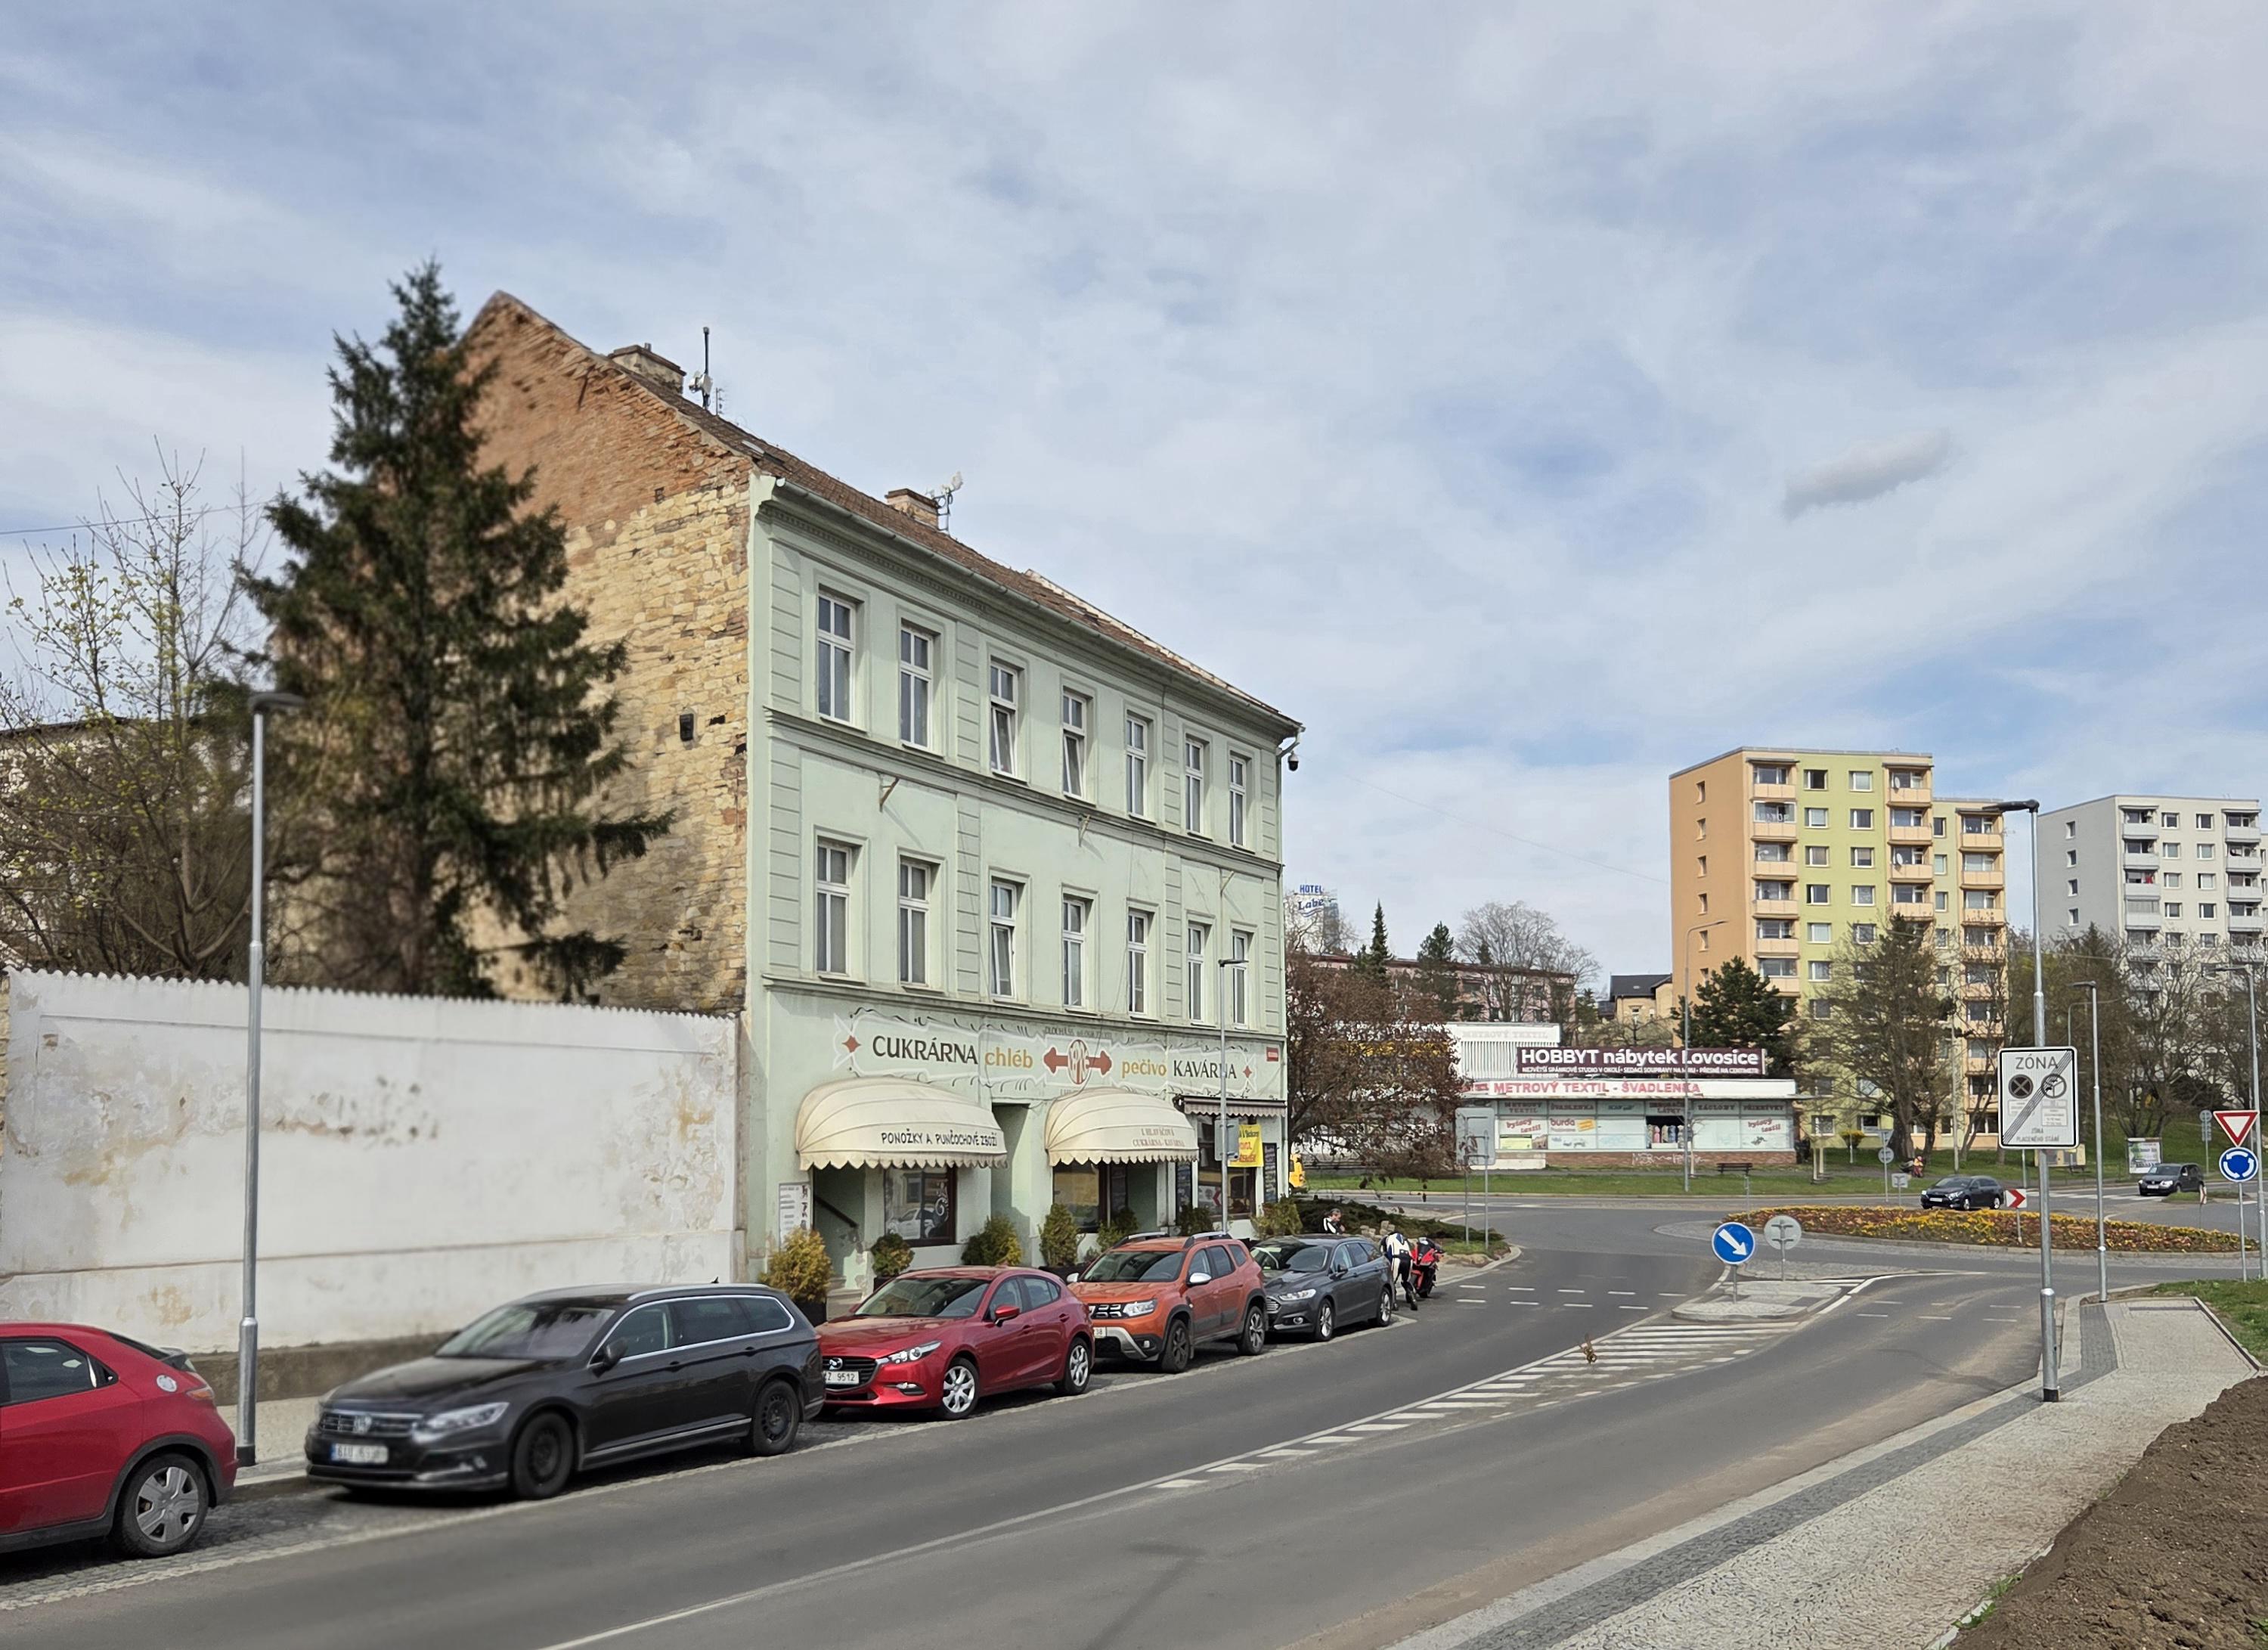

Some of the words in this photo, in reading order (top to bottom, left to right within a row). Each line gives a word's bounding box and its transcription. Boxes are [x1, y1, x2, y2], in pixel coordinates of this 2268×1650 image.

[1300, 885, 1323, 894] HOTEL
[1298, 898, 1324, 910] Labe
[872, 1035, 978, 1065] CUKRÁRNA
[984, 1046, 1033, 1069] chléb
[1521, 1049, 1600, 1064] HOBBYT
[1603, 1048, 1678, 1067] nábytek
[1682, 1048, 1758, 1065] Lovosice
[2015, 1053, 2058, 1069] ZÓNA
[1122, 1059, 1167, 1078] pečivo
[1173, 1059, 1237, 1079] KAVÁRNA
[1494, 1080, 1559, 1093] METROVÝ
[1563, 1082, 1610, 1093] TEXTIL
[1621, 1081, 1701, 1093] ŠVADLENKA
[1550, 1118, 1576, 1127] burda
[881, 1128, 923, 1144] PONOŽKY
[926, 1134, 933, 1145] A
[935, 1130, 980, 1146] PUNČOCHOVÉ
[838, 1372, 856, 1382] 9512
